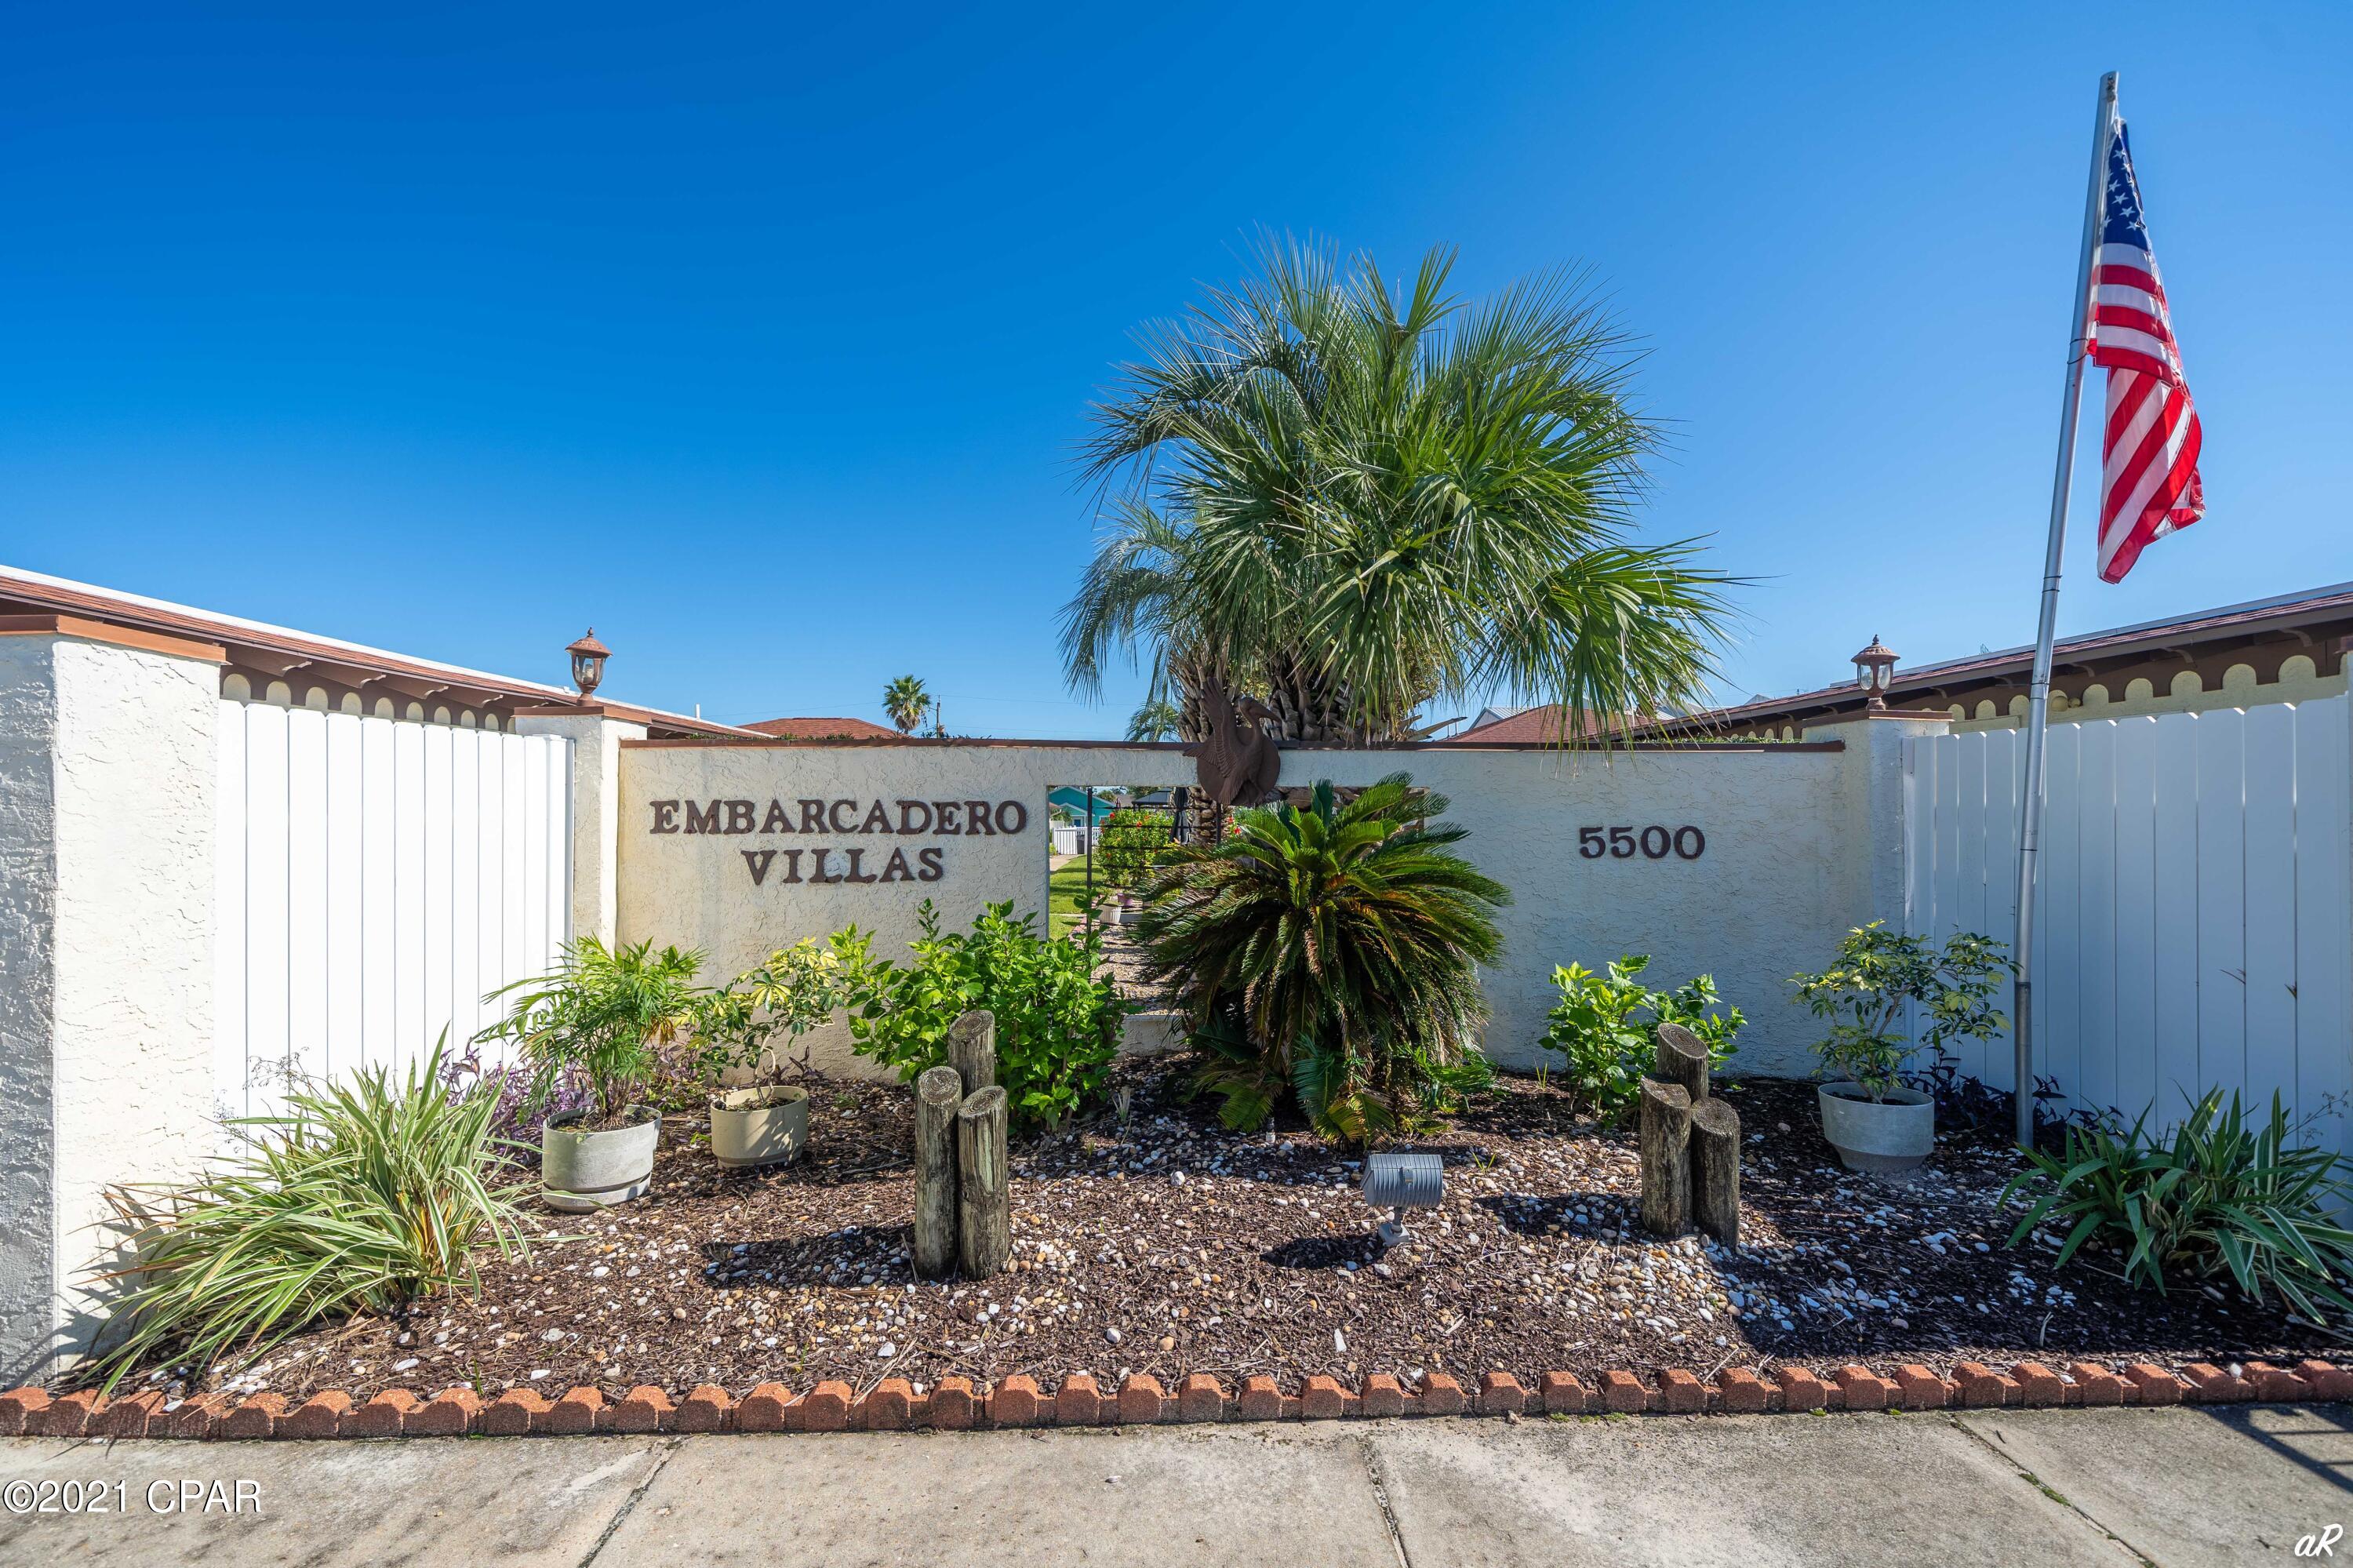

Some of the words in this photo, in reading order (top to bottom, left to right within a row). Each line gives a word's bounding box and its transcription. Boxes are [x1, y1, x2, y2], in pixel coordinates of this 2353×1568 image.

[649, 799, 1027, 835] EMBARCADERO
[1580, 825, 1705, 860] 5500
[741, 846, 944, 886] VILLAS
